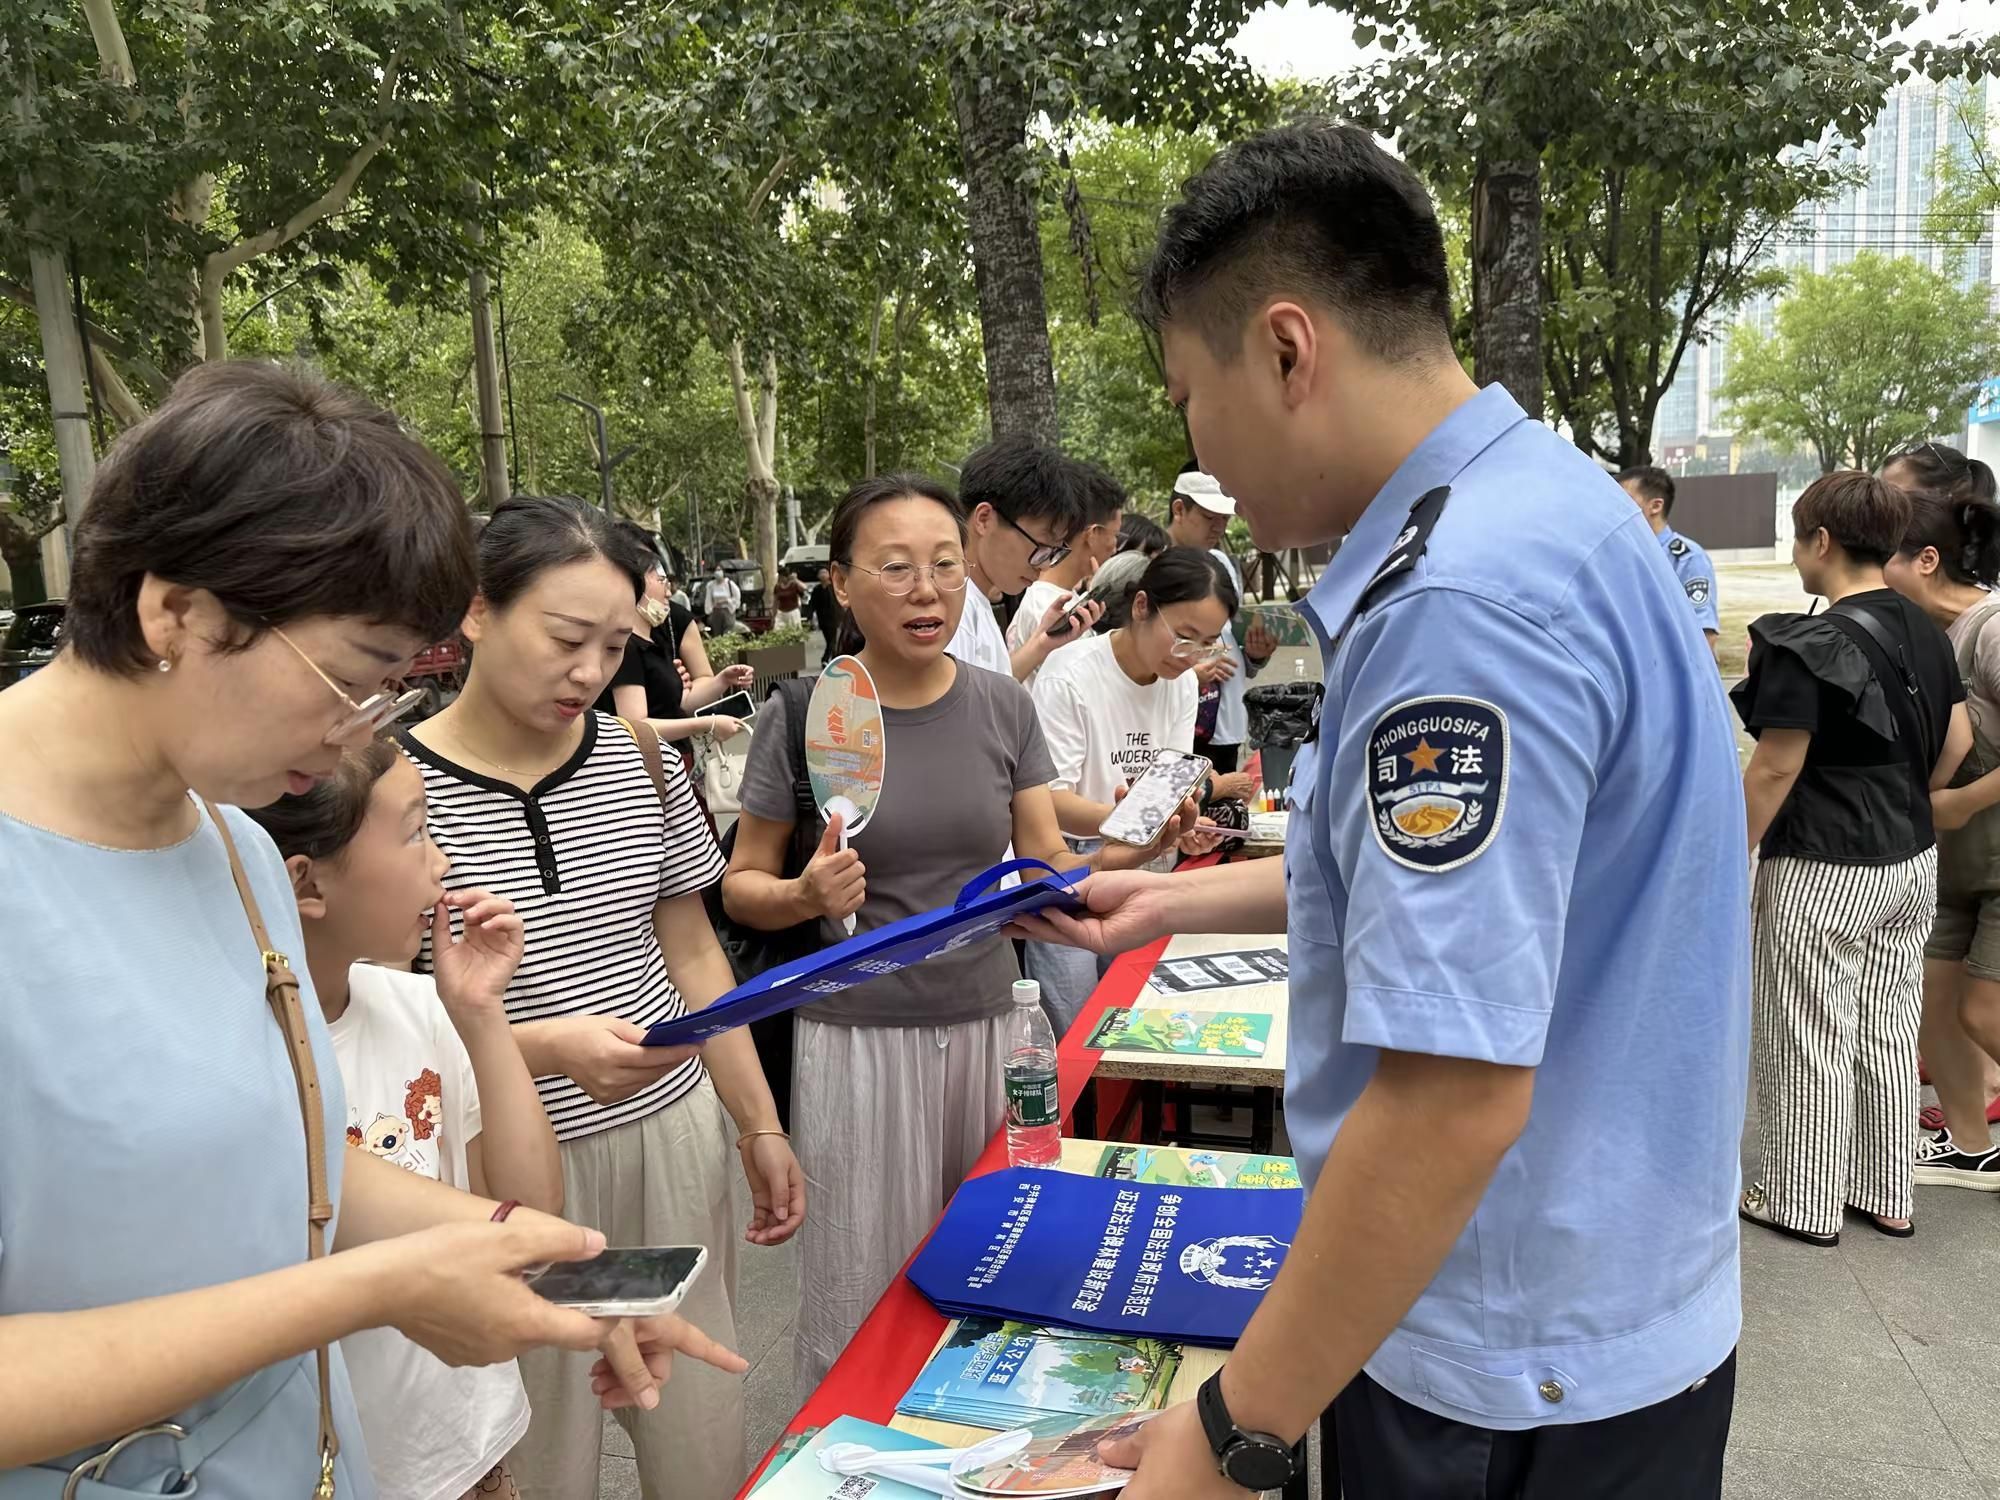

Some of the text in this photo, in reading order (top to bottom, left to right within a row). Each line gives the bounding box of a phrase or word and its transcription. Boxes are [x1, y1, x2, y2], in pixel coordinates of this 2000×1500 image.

[1125, 732, 1151, 746] THE
[1373, 716, 1490, 757] ZHONGGUOSIFA
[1376, 744, 1483, 783] 司 法
[1408, 780, 1442, 795] SIFA
[1071, 1189, 1141, 1313] 迈进法治碑林建设新征途
[1121, 1193, 1184, 1317] 争创全国法治政府示范区
[987, 1336, 1034, 1385] 蓝天公约
